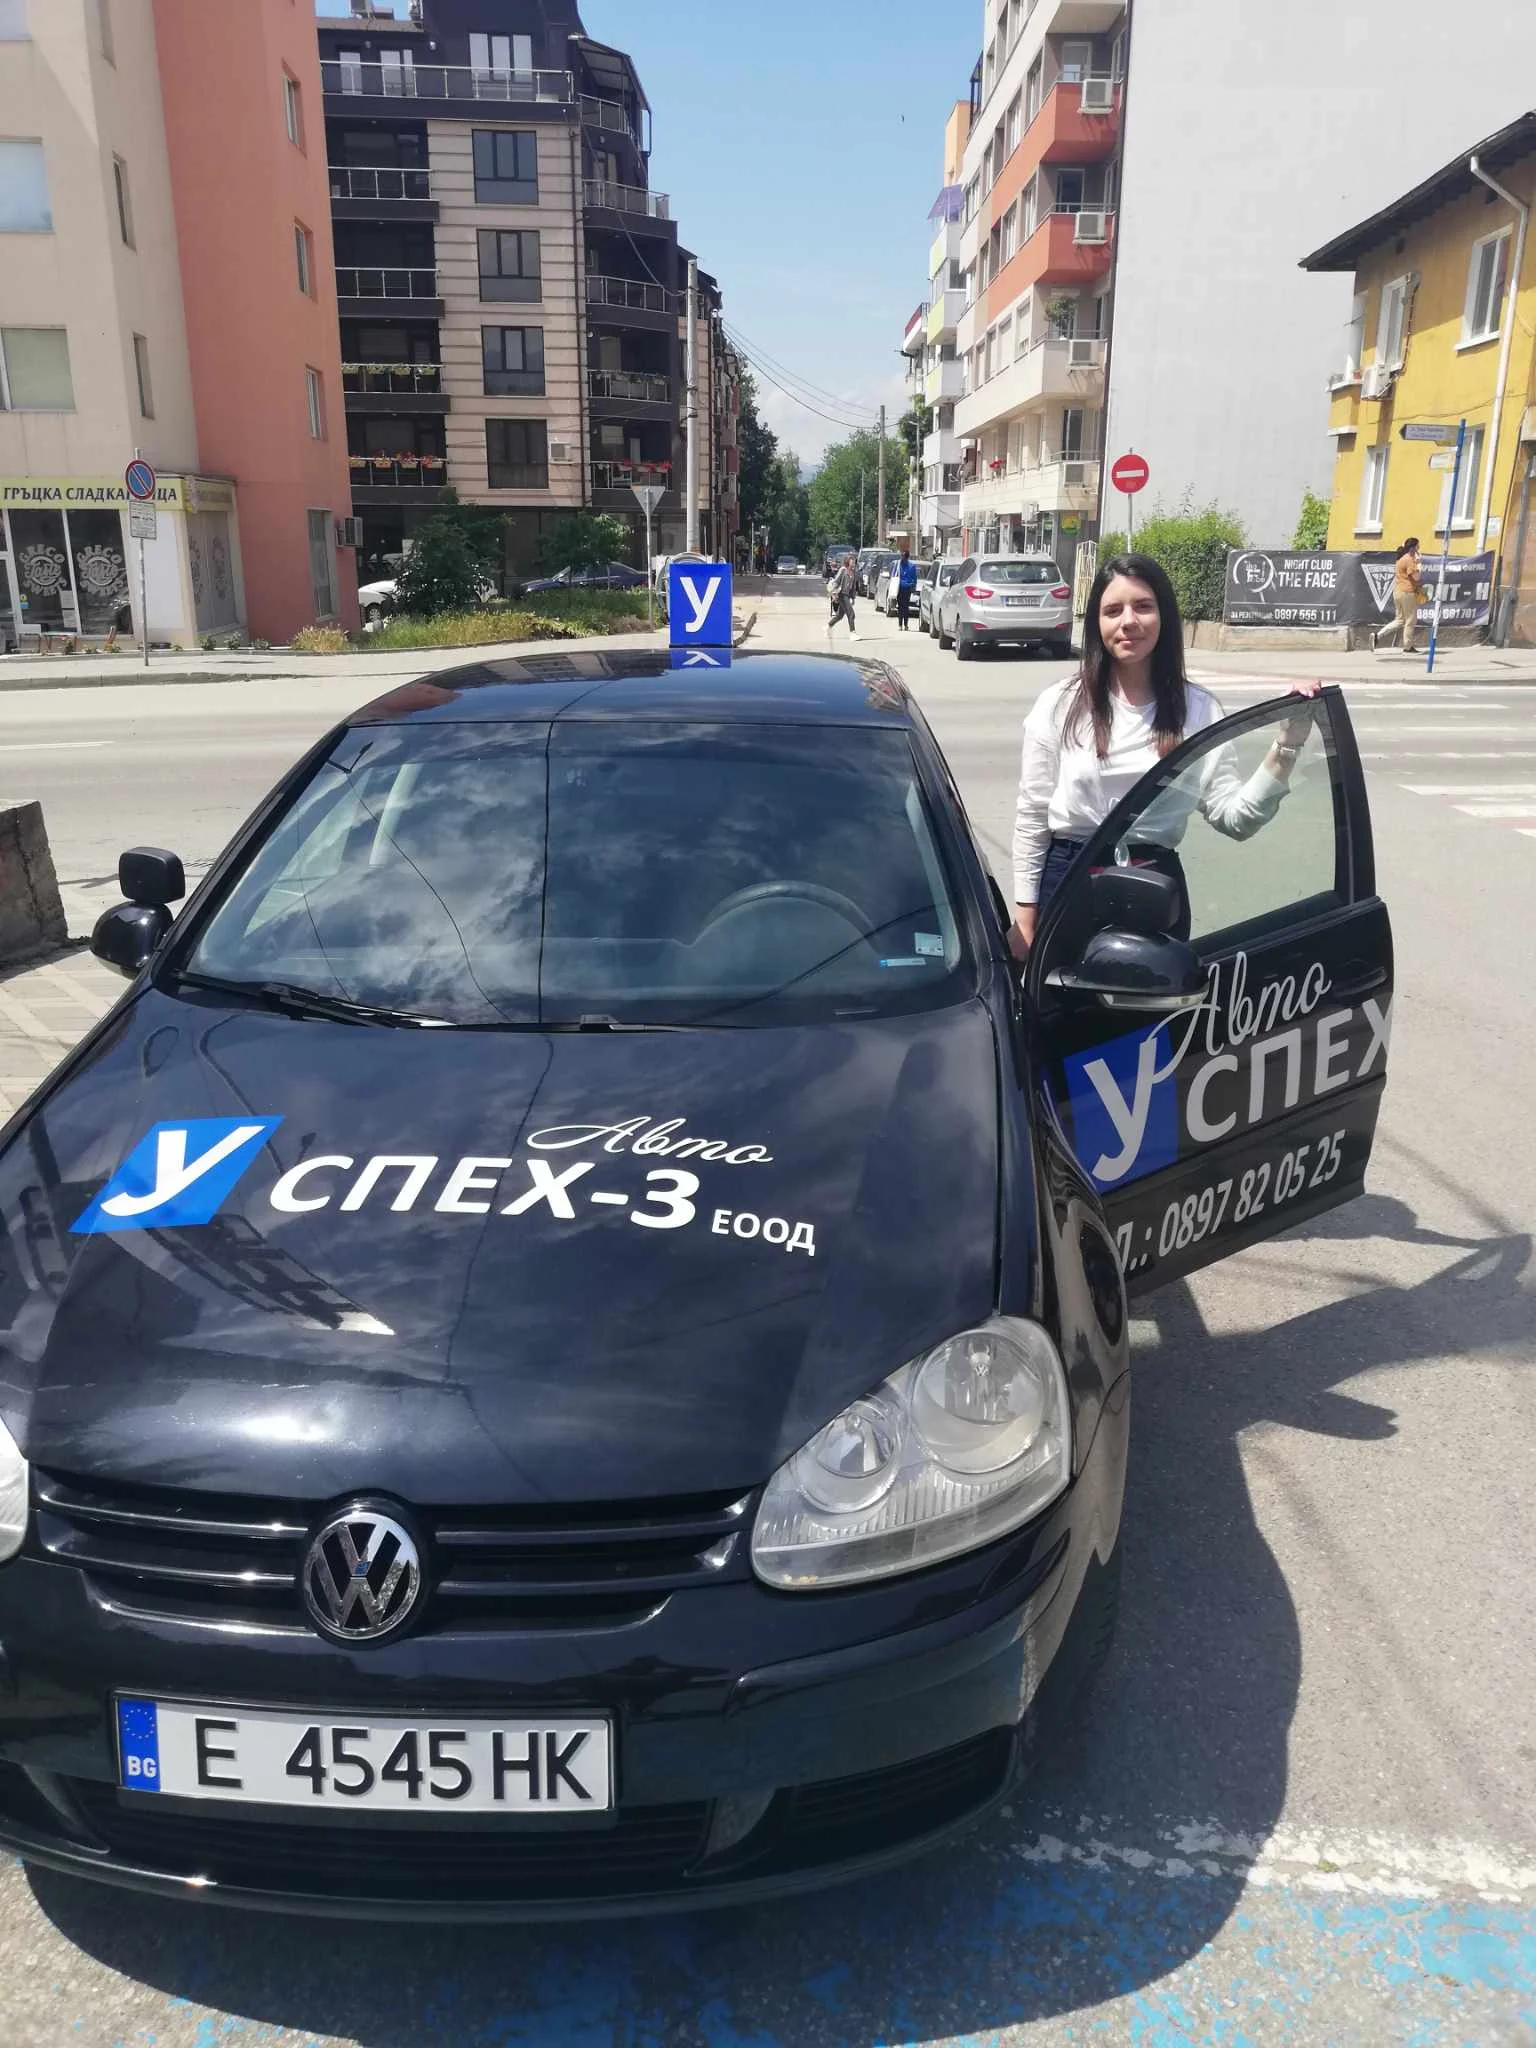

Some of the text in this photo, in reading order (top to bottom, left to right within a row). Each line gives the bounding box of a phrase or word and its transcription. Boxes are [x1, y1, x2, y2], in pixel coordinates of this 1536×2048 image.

[3, 487, 62, 502] ГРЪЦКА
[1278, 571, 1303, 588] THE
[1304, 571, 1338, 588] FACE
[1284, 559, 1333, 570] NIGHT CLUB
[1298, 609, 1318, 620] 555
[1320, 609, 1337, 621] 111
[527, 1115, 776, 1167] Авто
[1159, 1179, 1233, 1257] 0897
[1234, 1162, 1271, 1222] 82
[1273, 1145, 1310, 1205] 05
[1309, 1129, 1346, 1188] 25
[710, 1208, 817, 1257] ЕООД
[126, 1755, 158, 1778] BG
[285, 1726, 474, 1801] 4545
